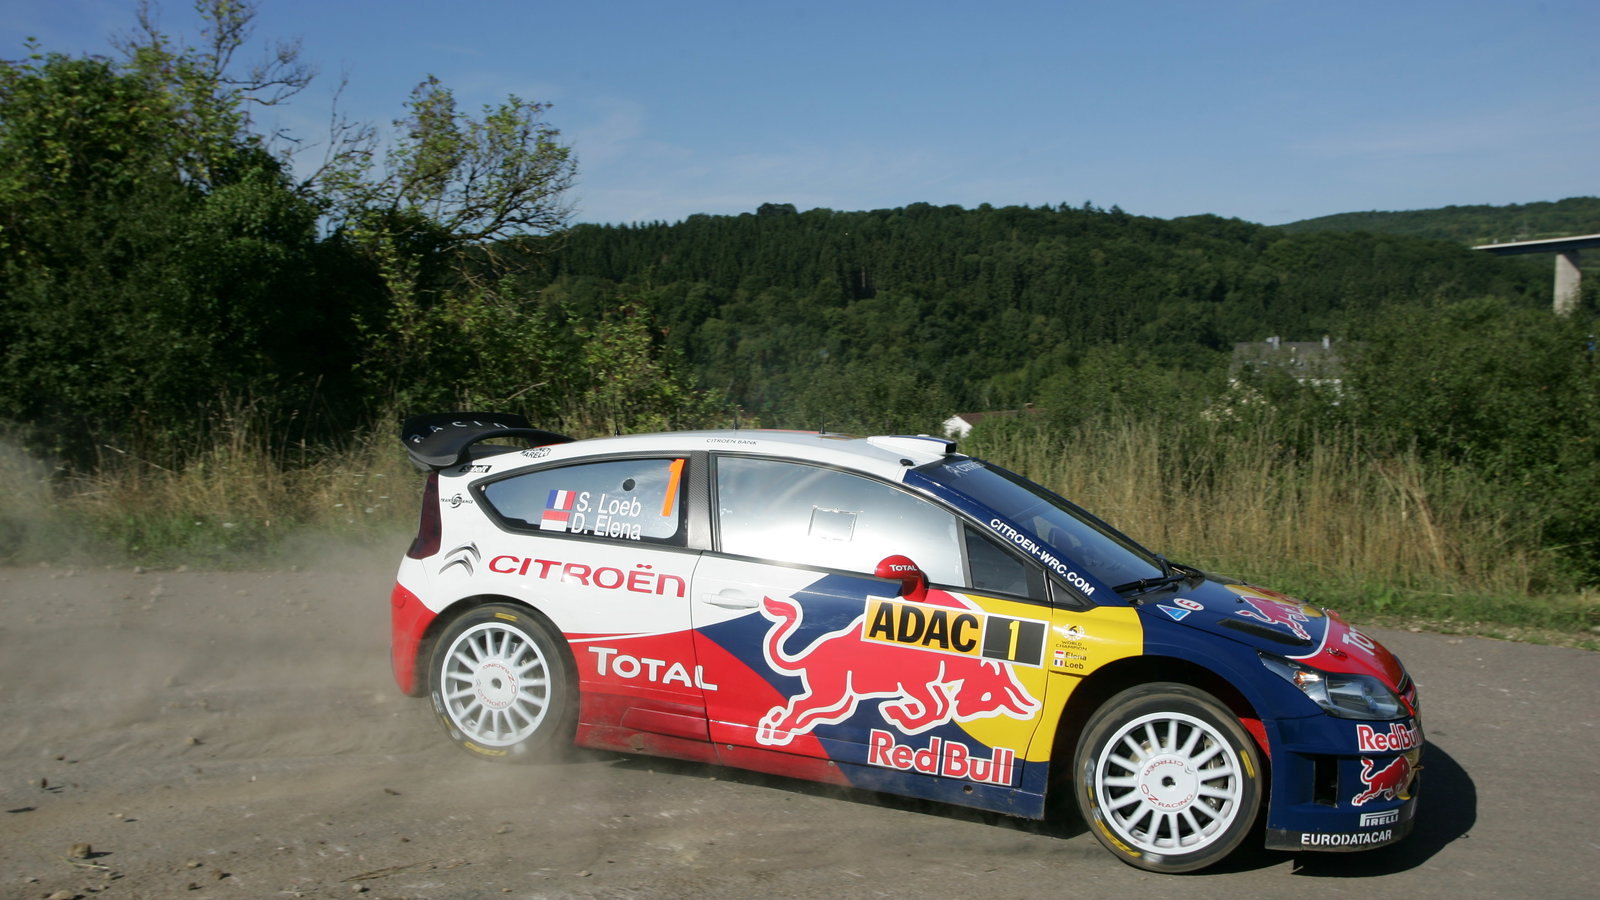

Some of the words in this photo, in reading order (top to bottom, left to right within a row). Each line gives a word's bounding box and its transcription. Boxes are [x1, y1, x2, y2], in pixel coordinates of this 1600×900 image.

[410, 420, 513, 444] RACIN
[660, 458, 685, 518] 1
[576, 491, 592, 513] S.
[598, 493, 642, 517] Loeb
[571, 512, 587, 534] D.
[594, 515, 642, 541] Elena
[889, 563, 918, 572] TOTAL
[990, 518, 1095, 596] CITROEN-WRC.COM
[488, 555, 686, 598] CITROËN
[868, 601, 979, 653] ADAC
[1007, 620, 1021, 661] 1
[1055, 643, 1088, 652] CHAMPION
[1065, 651, 1087, 661] Elena
[588, 646, 719, 691] TOTAL
[1064, 660, 1084, 670] Loeb
[1356, 723, 1398, 752] Red
[868, 728, 941, 775] Red
[942, 740, 1015, 787] Bull
[1158, 794, 1193, 808] RACING
[1360, 808, 1399, 827] PIRELLI
[1301, 829, 1392, 846] EURODATACAR
